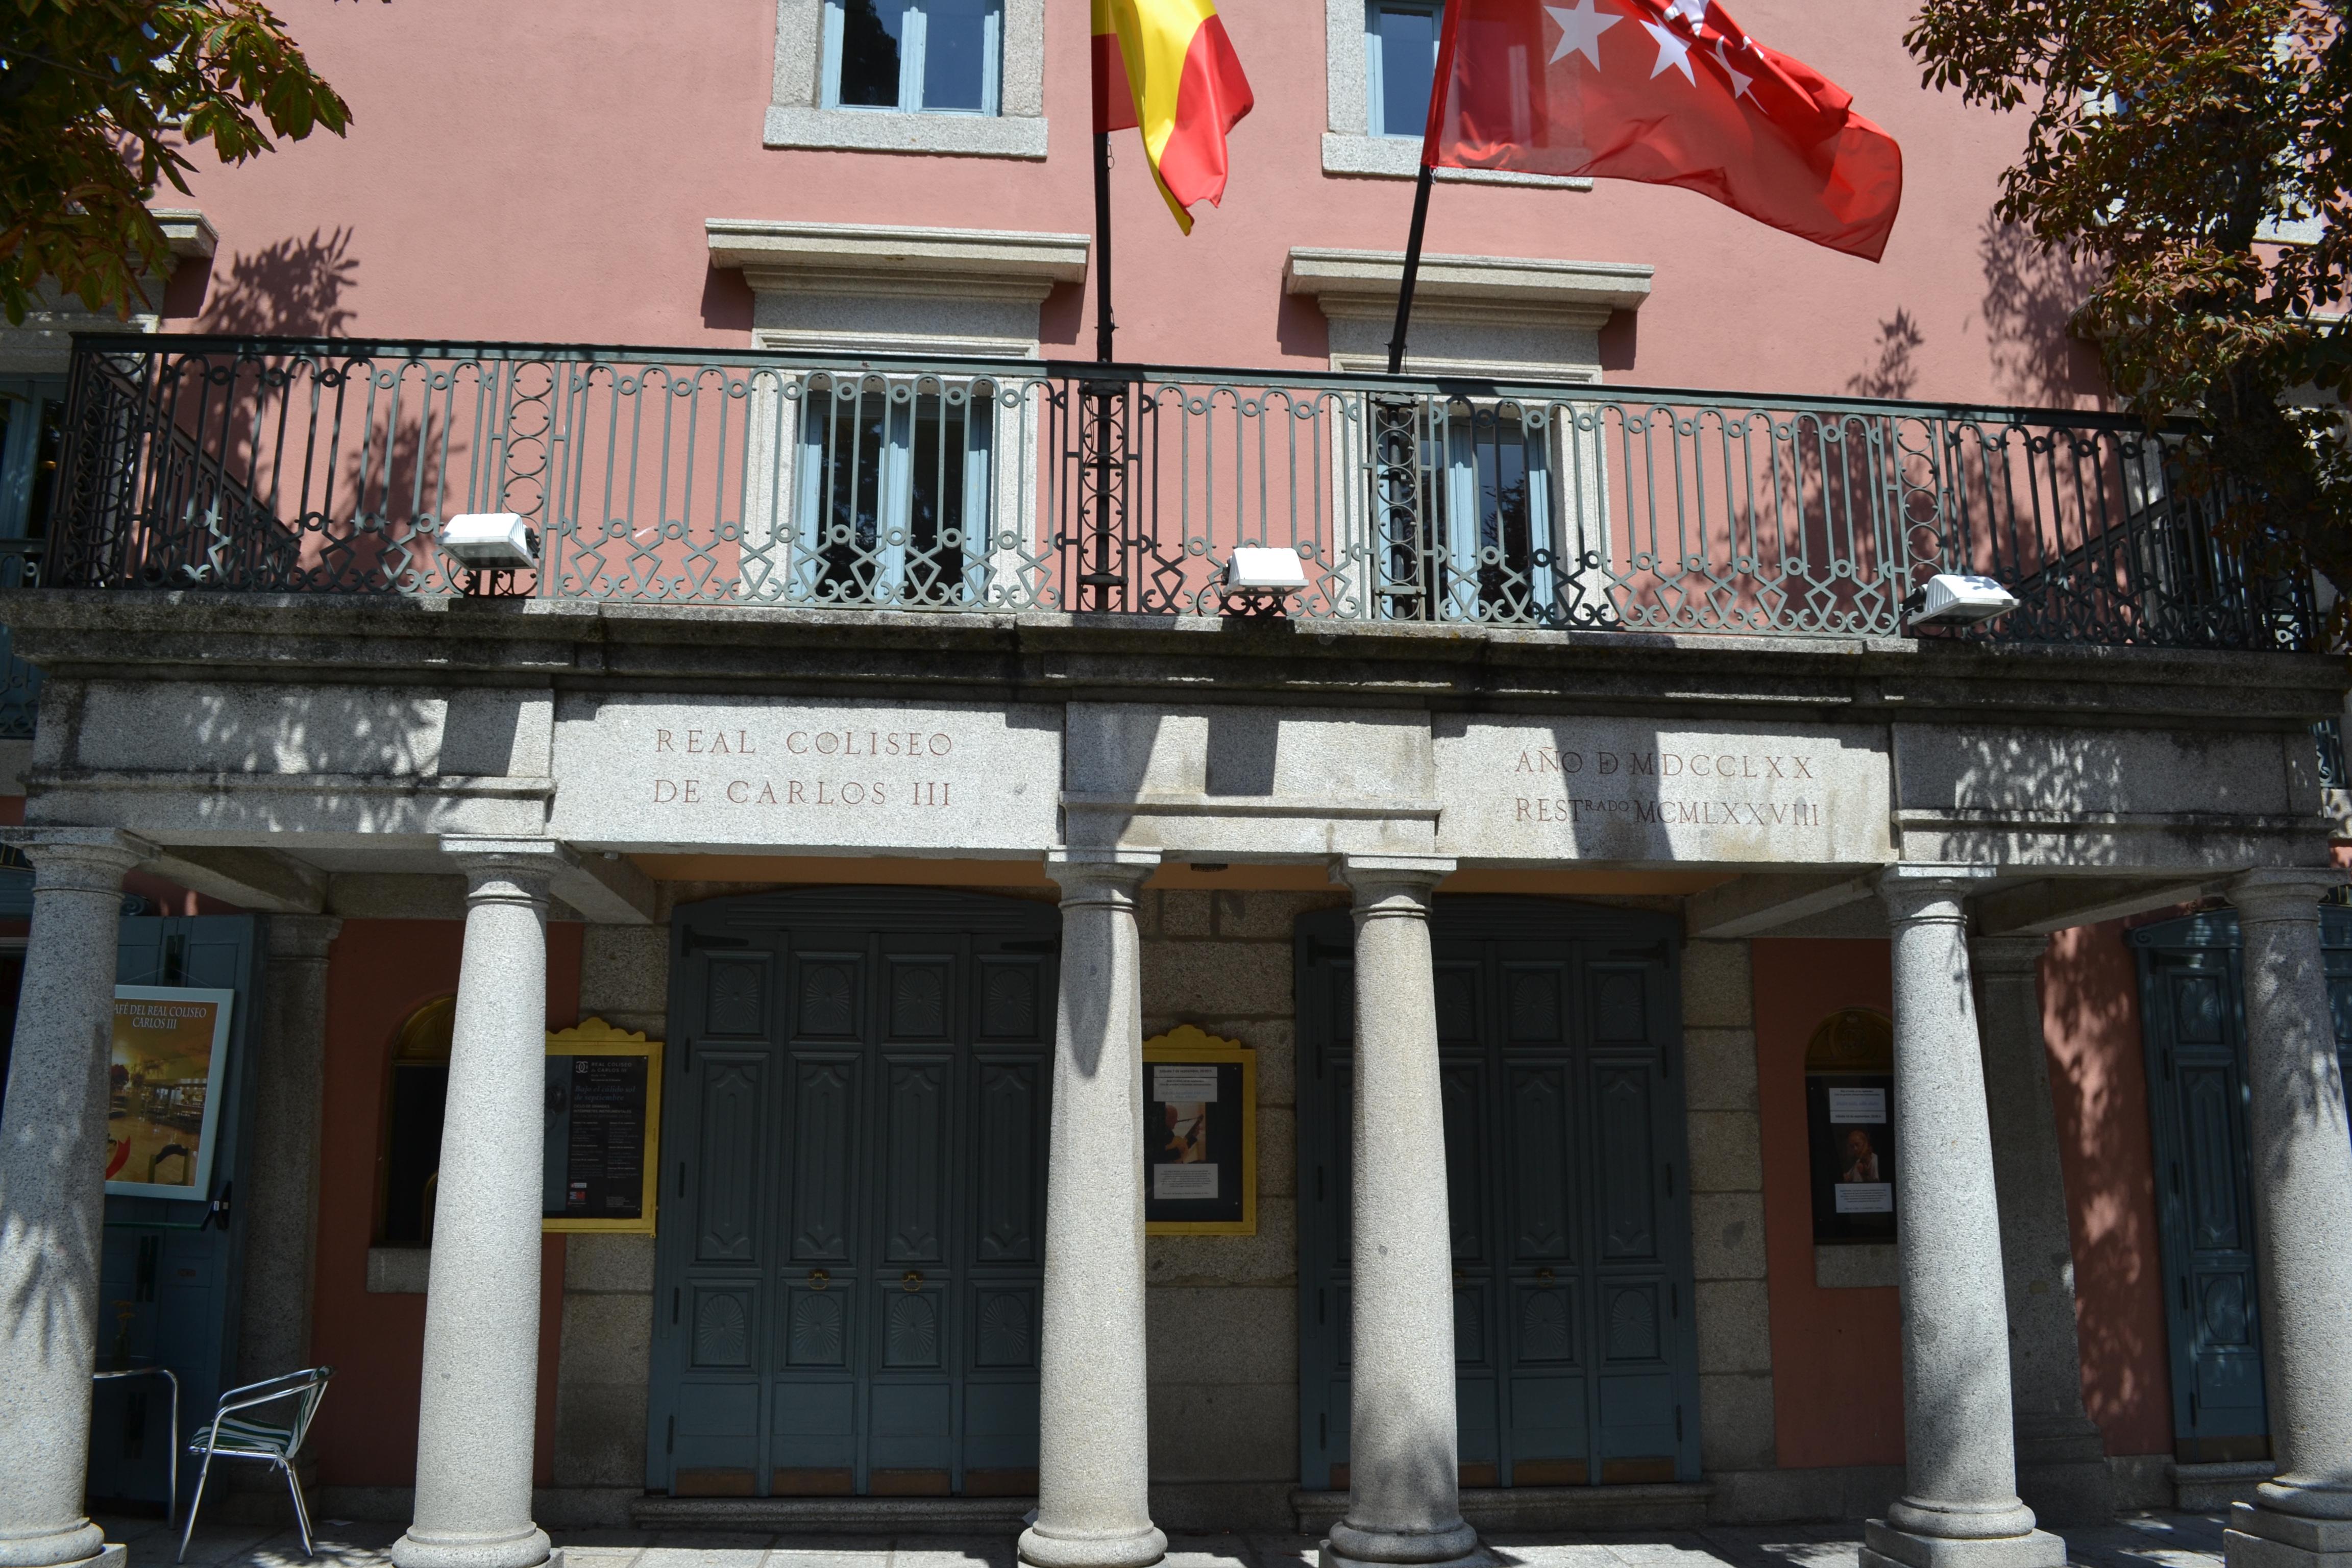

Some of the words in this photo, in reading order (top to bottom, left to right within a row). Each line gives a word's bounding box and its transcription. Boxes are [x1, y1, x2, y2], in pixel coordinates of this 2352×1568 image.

[655, 729, 756, 754] REAL
[787, 731, 952, 756] COLISEO
[1515, 746, 1583, 773] AÑO
[1630, 752, 1814, 779] MDCCLXX
[654, 779, 701, 804] DE
[726, 780, 886, 805] CARLOS
[912, 781, 951, 806] III
[1634, 800, 1820, 826] MCMLXXVIII
[114, 1002, 129, 1014] AFÉ
[130, 1005, 146, 1015] DEL
[148, 1006, 167, 1016] REAL
[169, 1007, 207, 1018] COLISEO
[132, 1017, 165, 1028] CARLOS
[166, 1019, 177, 1030] III
[583, 1094, 625, 1102] septiembre
